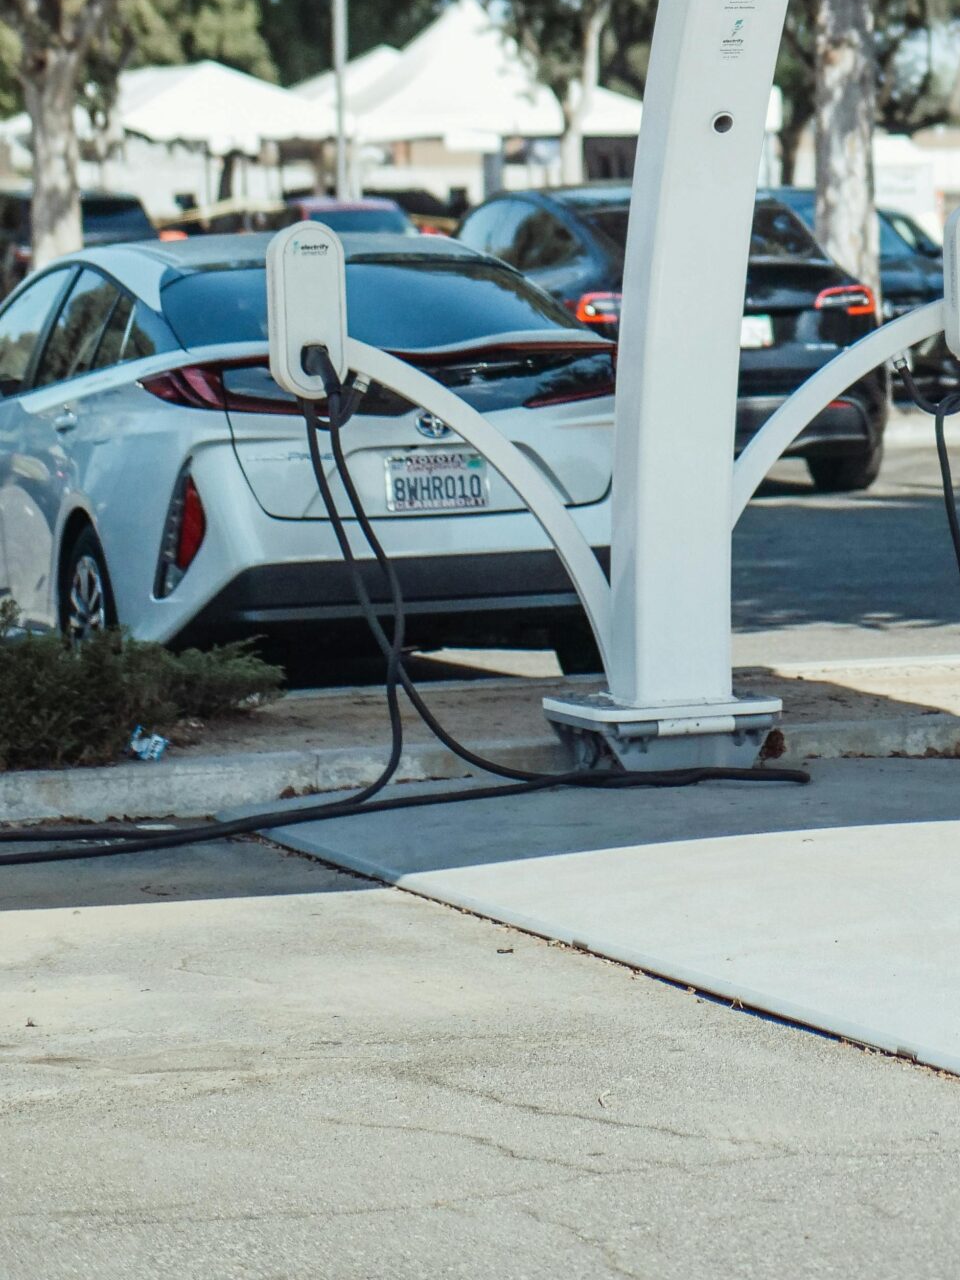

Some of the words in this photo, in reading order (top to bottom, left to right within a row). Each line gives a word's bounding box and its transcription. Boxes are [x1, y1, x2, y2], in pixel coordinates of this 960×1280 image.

[301, 244, 328, 252] electrify
[411, 454, 465, 464] TOYOTA
[394, 474, 482, 501] 8WHR010
